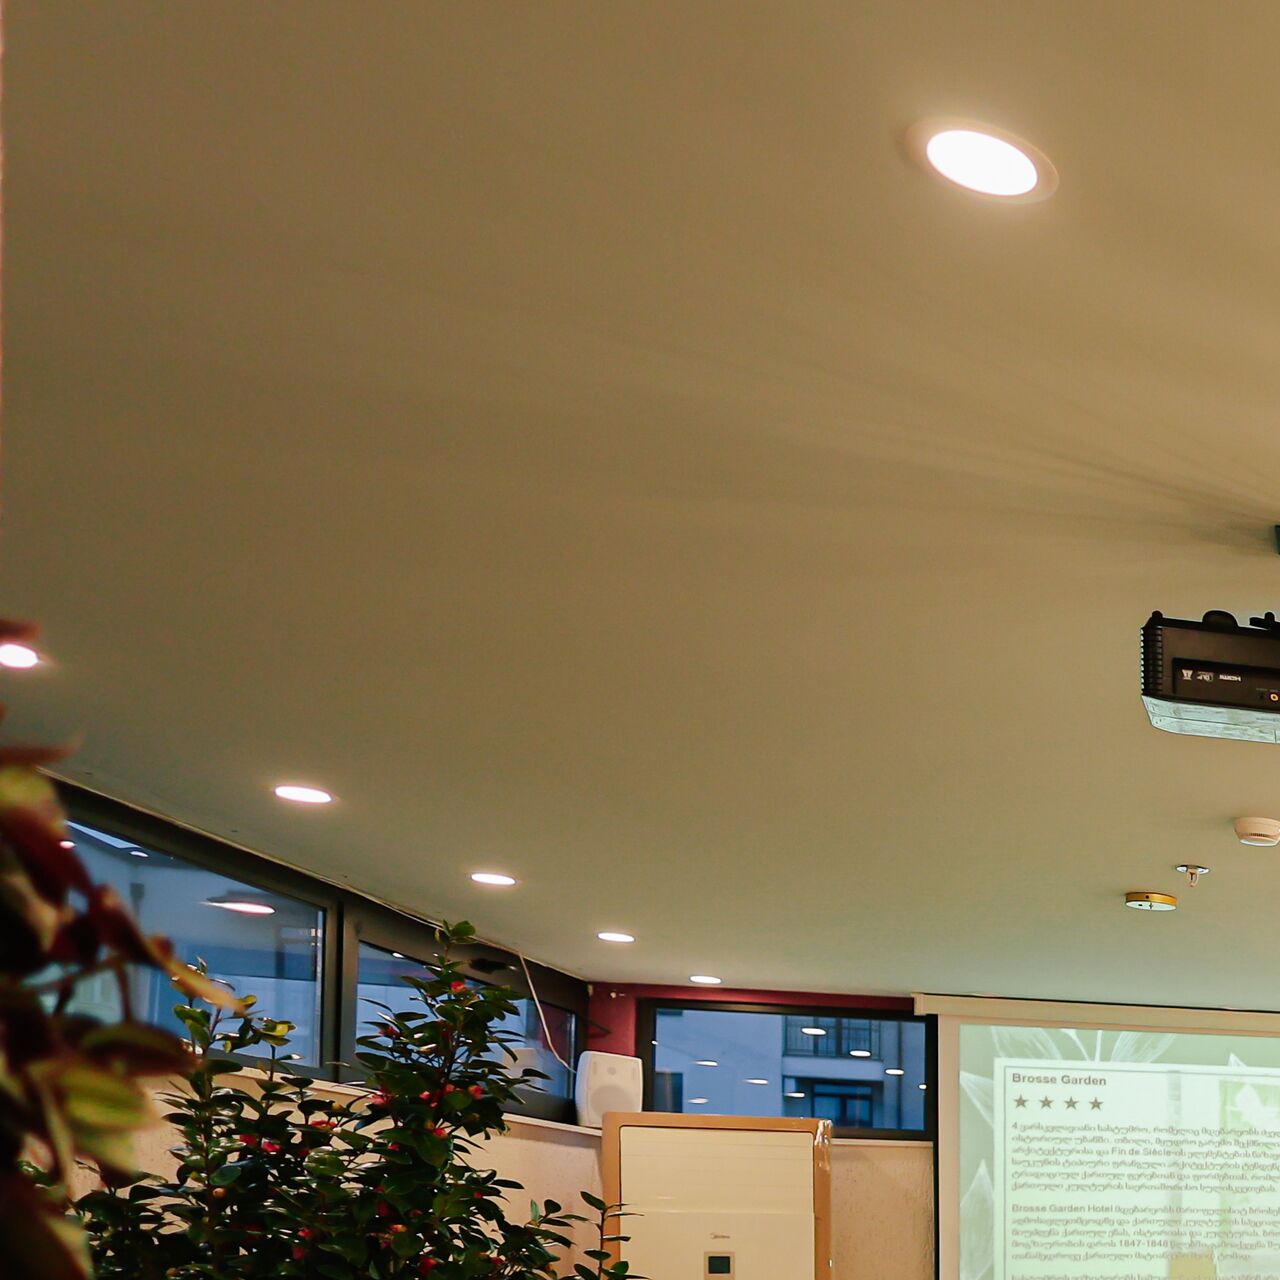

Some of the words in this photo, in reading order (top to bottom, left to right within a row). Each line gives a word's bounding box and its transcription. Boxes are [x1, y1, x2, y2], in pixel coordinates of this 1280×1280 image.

[1012, 1073, 1057, 1085] Brosse
[1061, 1074, 1107, 1087] Garden
[1012, 1121, 1018, 1129] 4
[1112, 1146, 1126, 1155] Fin
[1128, 1147, 1141, 1156] de
[1012, 1203, 1047, 1212] Brosse
[1049, 1203, 1085, 1213] Garden
[1087, 1203, 1113, 1213] Hotel
